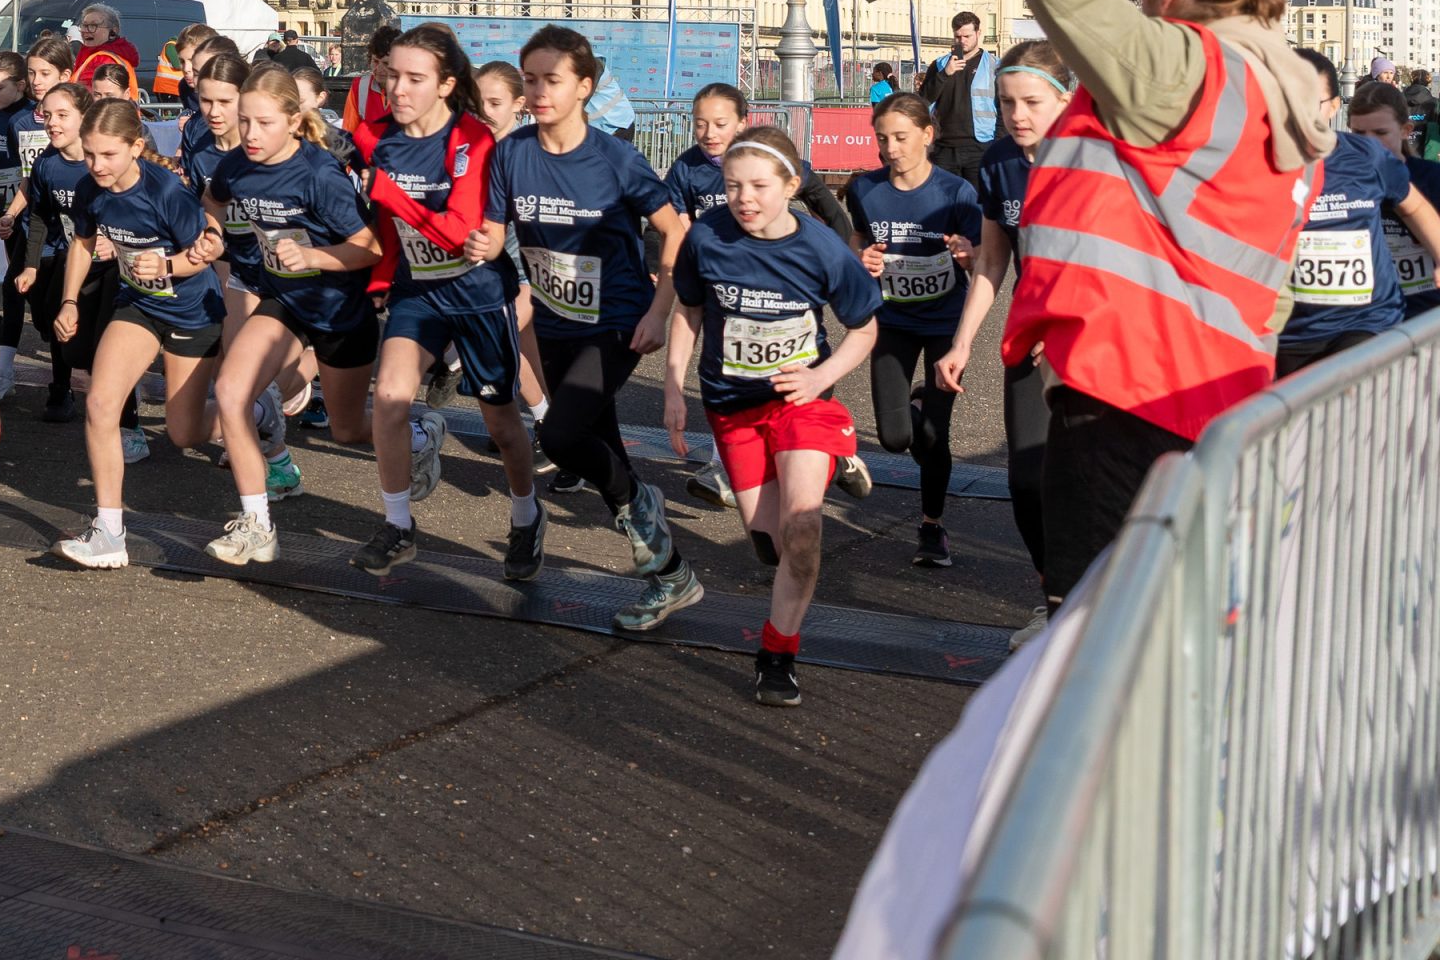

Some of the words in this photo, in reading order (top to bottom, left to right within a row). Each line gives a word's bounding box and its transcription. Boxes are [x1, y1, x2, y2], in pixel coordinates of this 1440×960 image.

[845, 135, 872, 145] OUT
[540, 196, 575, 208] Brighton
[1315, 193, 1347, 203] ighton
[539, 205, 558, 215] Half
[559, 207, 603, 217] Marathon
[1330, 200, 1375, 210] Marathon
[891, 221, 923, 230] Brighton
[406, 239, 458, 265] 136
[532, 262, 594, 307] 13609
[885, 271, 950, 297] 13687
[742, 289, 782, 300] Brighton
[741, 297, 762, 308] Half
[763, 300, 810, 310] Marathon
[731, 331, 812, 365] 13637
